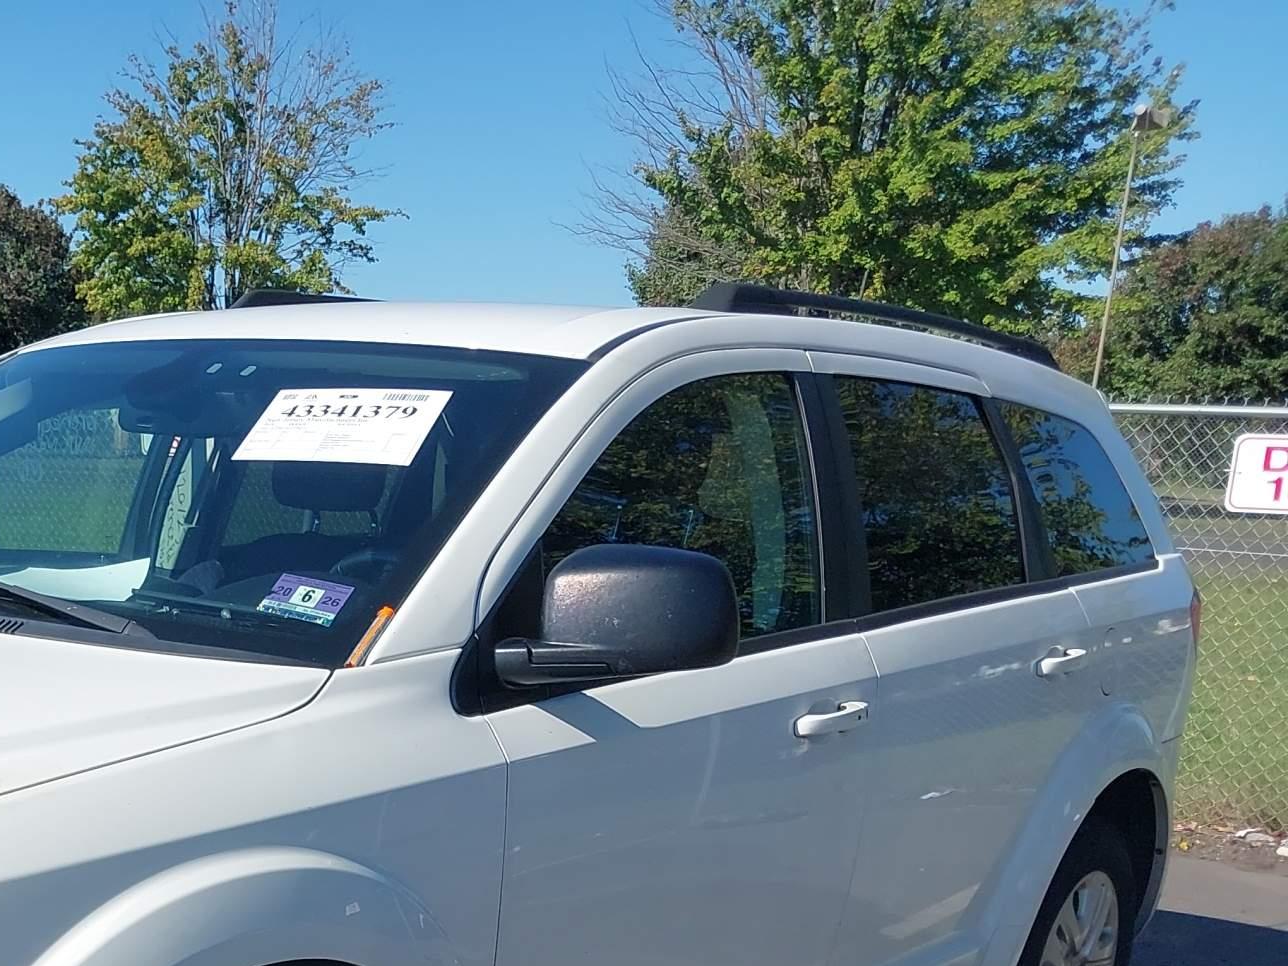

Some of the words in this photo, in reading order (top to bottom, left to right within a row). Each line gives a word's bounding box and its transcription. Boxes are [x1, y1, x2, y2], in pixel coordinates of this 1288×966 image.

[280, 404, 419, 419] 43341379
[276, 585, 293, 597] 20
[302, 589, 316, 603] 6
[322, 596, 341, 607] 26
